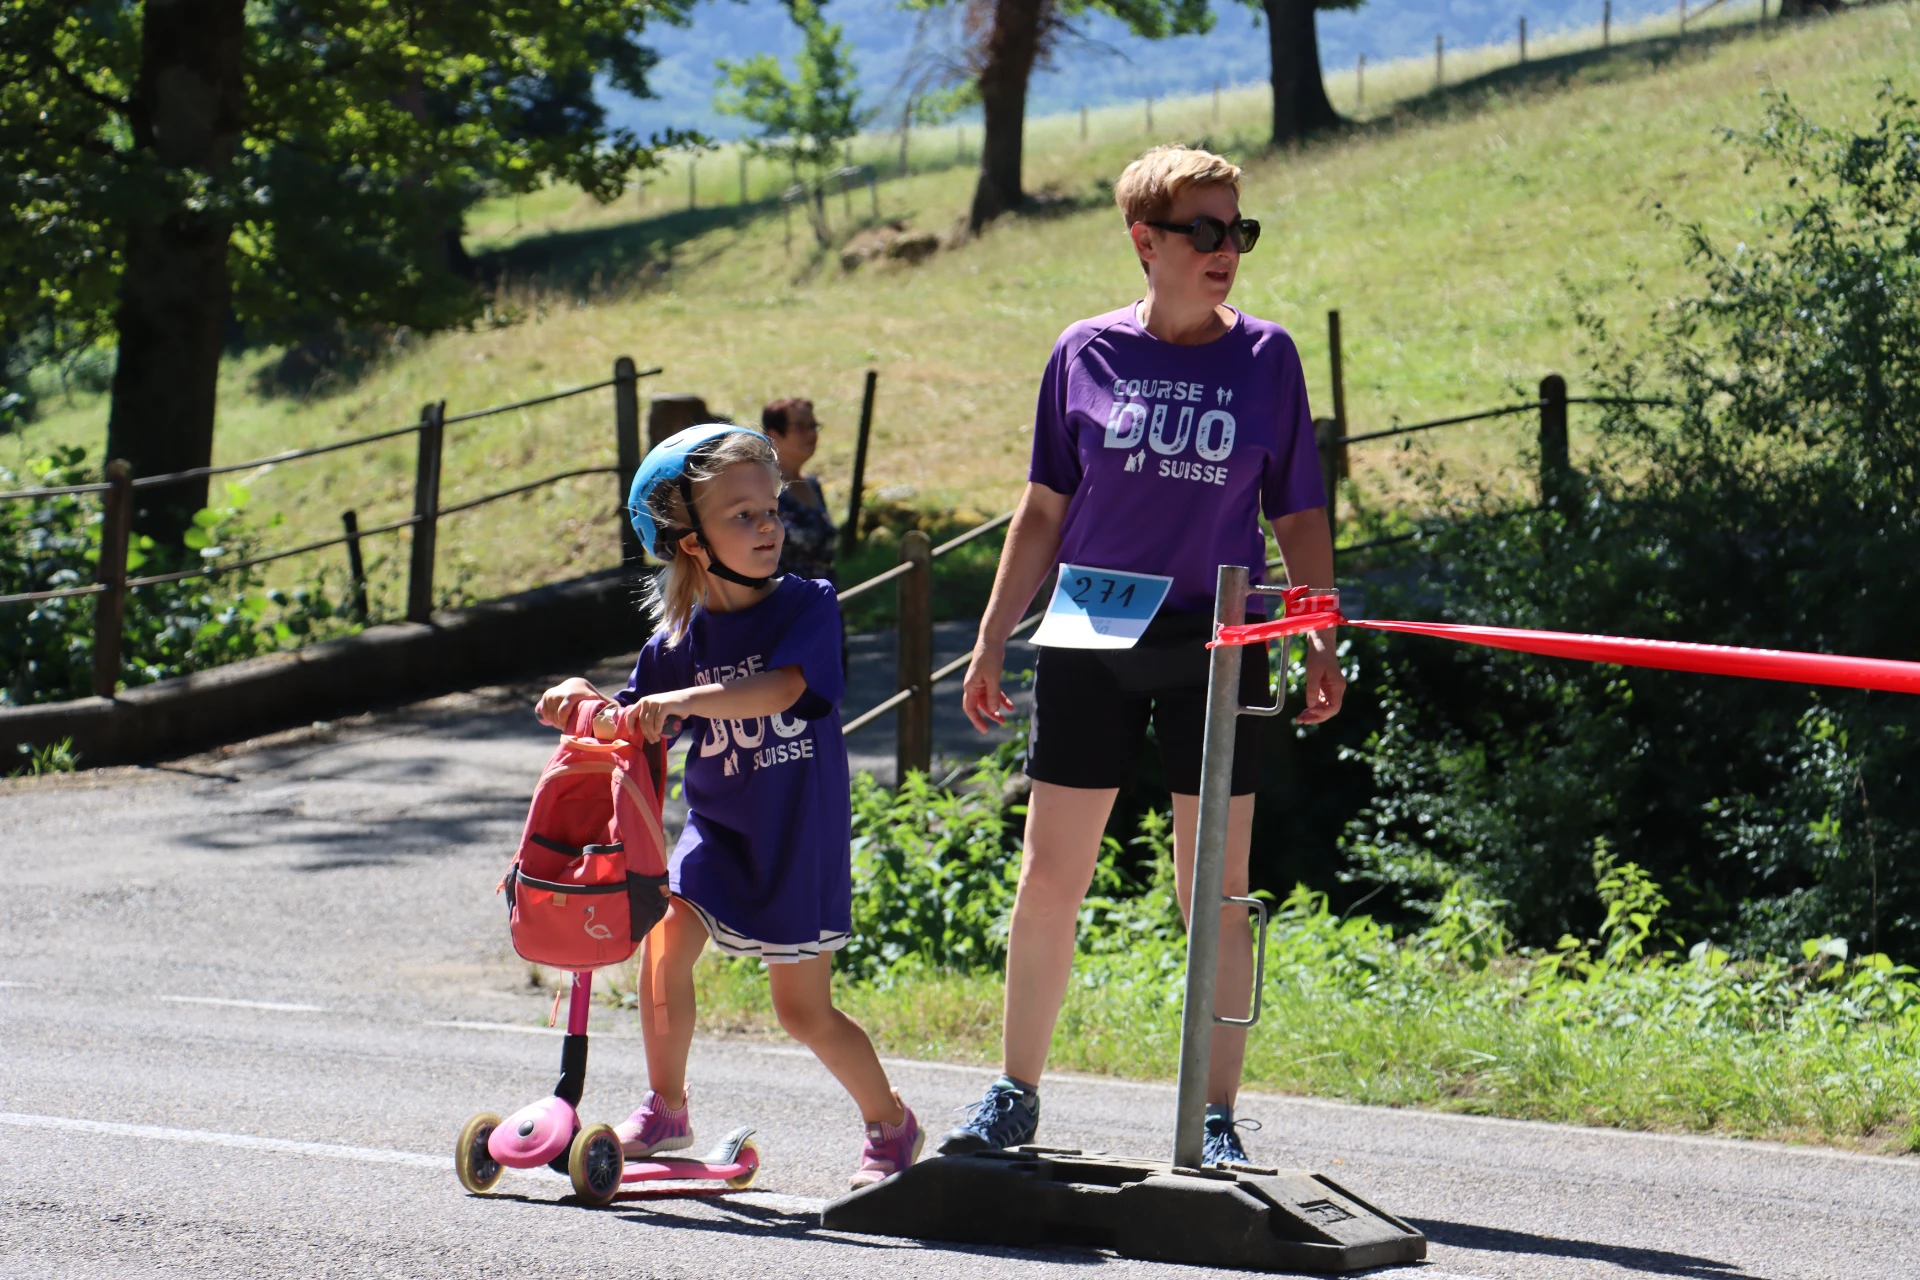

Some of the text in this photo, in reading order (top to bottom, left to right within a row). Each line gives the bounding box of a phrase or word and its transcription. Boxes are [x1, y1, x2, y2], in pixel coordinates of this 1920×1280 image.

[1113, 379, 1204, 402] COURSE
[1103, 401, 1236, 462] DUO
[1158, 459, 1228, 486] SUISSE
[1072, 576, 1136, 608] 271
[694, 654, 764, 687] OURSE
[753, 738, 814, 771] SUISSE
